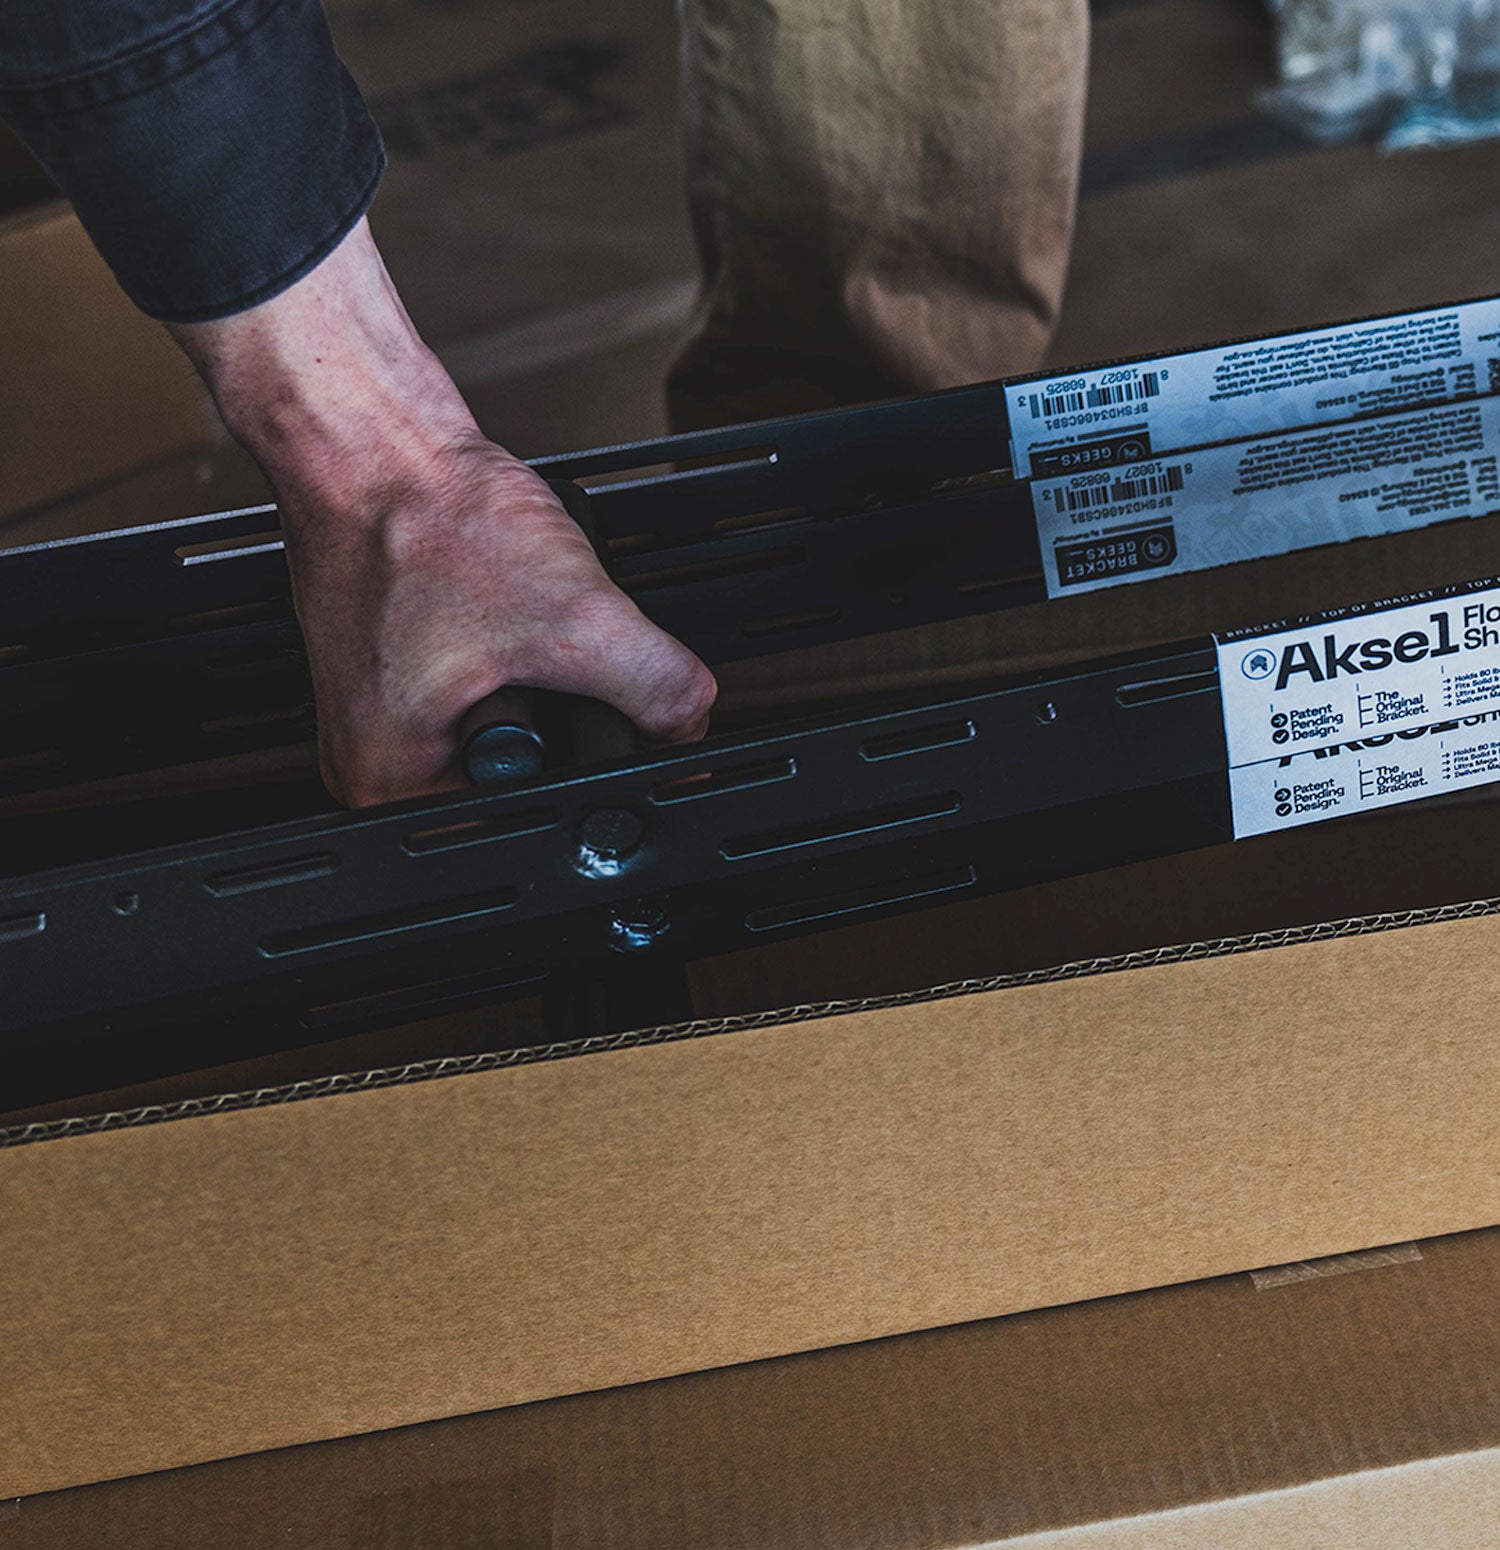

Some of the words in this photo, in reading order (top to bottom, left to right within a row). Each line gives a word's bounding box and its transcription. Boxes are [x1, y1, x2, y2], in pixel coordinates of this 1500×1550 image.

[1045, 377, 1087, 403] 60825
[1100, 368, 1140, 393] 10027
[1017, 395, 1026, 407] 3
[1060, 446, 1111, 466] GEEKS
[1124, 461, 1165, 487] 10027
[1069, 471, 1113, 497] 60825
[1041, 489, 1051, 501] 3
[1086, 540, 1136, 559] GEEKS
[1066, 553, 1137, 578] BRACKET
[1225, 619, 1287, 638] BRACKET
[1320, 607, 1348, 619] TOP
[1350, 603, 1366, 613] OF
[1372, 589, 1434, 608] BRACKET
[1465, 577, 1492, 589] TOP
[1274, 612, 1460, 691] Aksel
[1454, 672, 1478, 682] Holds
[1479, 668, 1490, 677] 80
[1471, 676, 1492, 686] Solid
[1374, 690, 1399, 703] The
[1455, 689, 1475, 698] Ultra
[1477, 684, 1500, 692] Mega
[1455, 694, 1487, 705] Delivers
[1289, 703, 1332, 722] Patent
[1375, 693, 1423, 713] Original
[1376, 704, 1428, 723] Bracket.
[1290, 713, 1343, 734] Pending
[1291, 720, 1339, 741] Design.
[1453, 747, 1476, 756] Holds
[1470, 750, 1490, 760] Solid
[1375, 765, 1399, 778] The
[1453, 762, 1473, 770] Ultra
[1475, 756, 1497, 766] Mega
[1454, 766, 1485, 778] Delivers
[1376, 767, 1422, 786] Original
[1376, 777, 1428, 795] Bracket.
[1292, 777, 1334, 796] Patent
[1293, 786, 1345, 806] Pending
[1294, 794, 1341, 813] Design.
